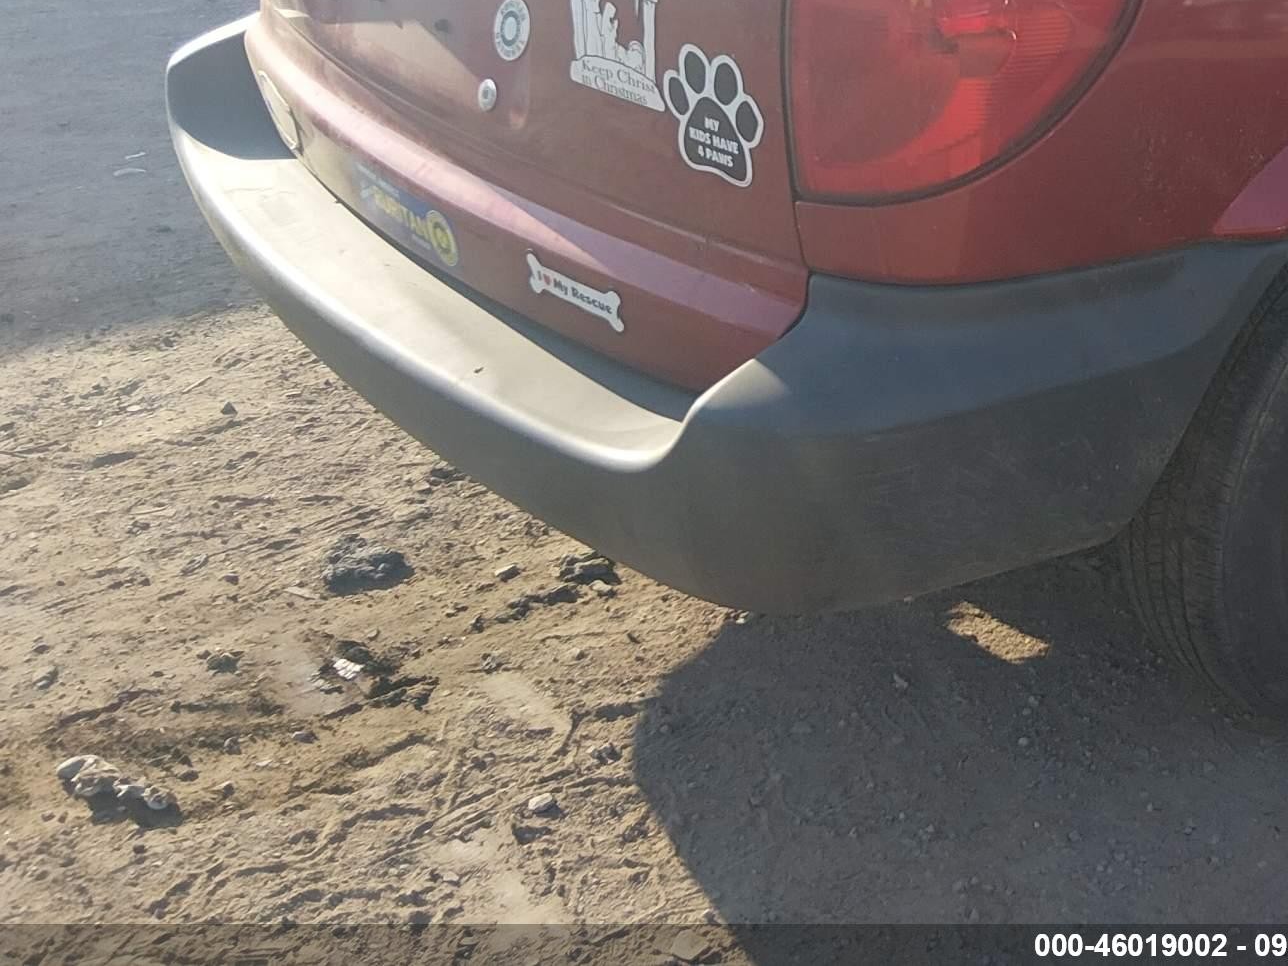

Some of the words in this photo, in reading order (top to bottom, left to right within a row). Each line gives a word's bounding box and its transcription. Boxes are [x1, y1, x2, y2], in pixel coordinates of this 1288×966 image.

[581, 74, 592, 87] in
[594, 75, 648, 106] Christmas
[582, 59, 613, 81] Keep
[617, 68, 656, 94] Christ
[704, 116, 720, 132] MY
[689, 126, 712, 145] KIDS
[712, 134, 739, 155] HAVE
[705, 147, 734, 168] PAWS
[553, 277, 569, 296] My
[571, 286, 613, 315] Rescue
